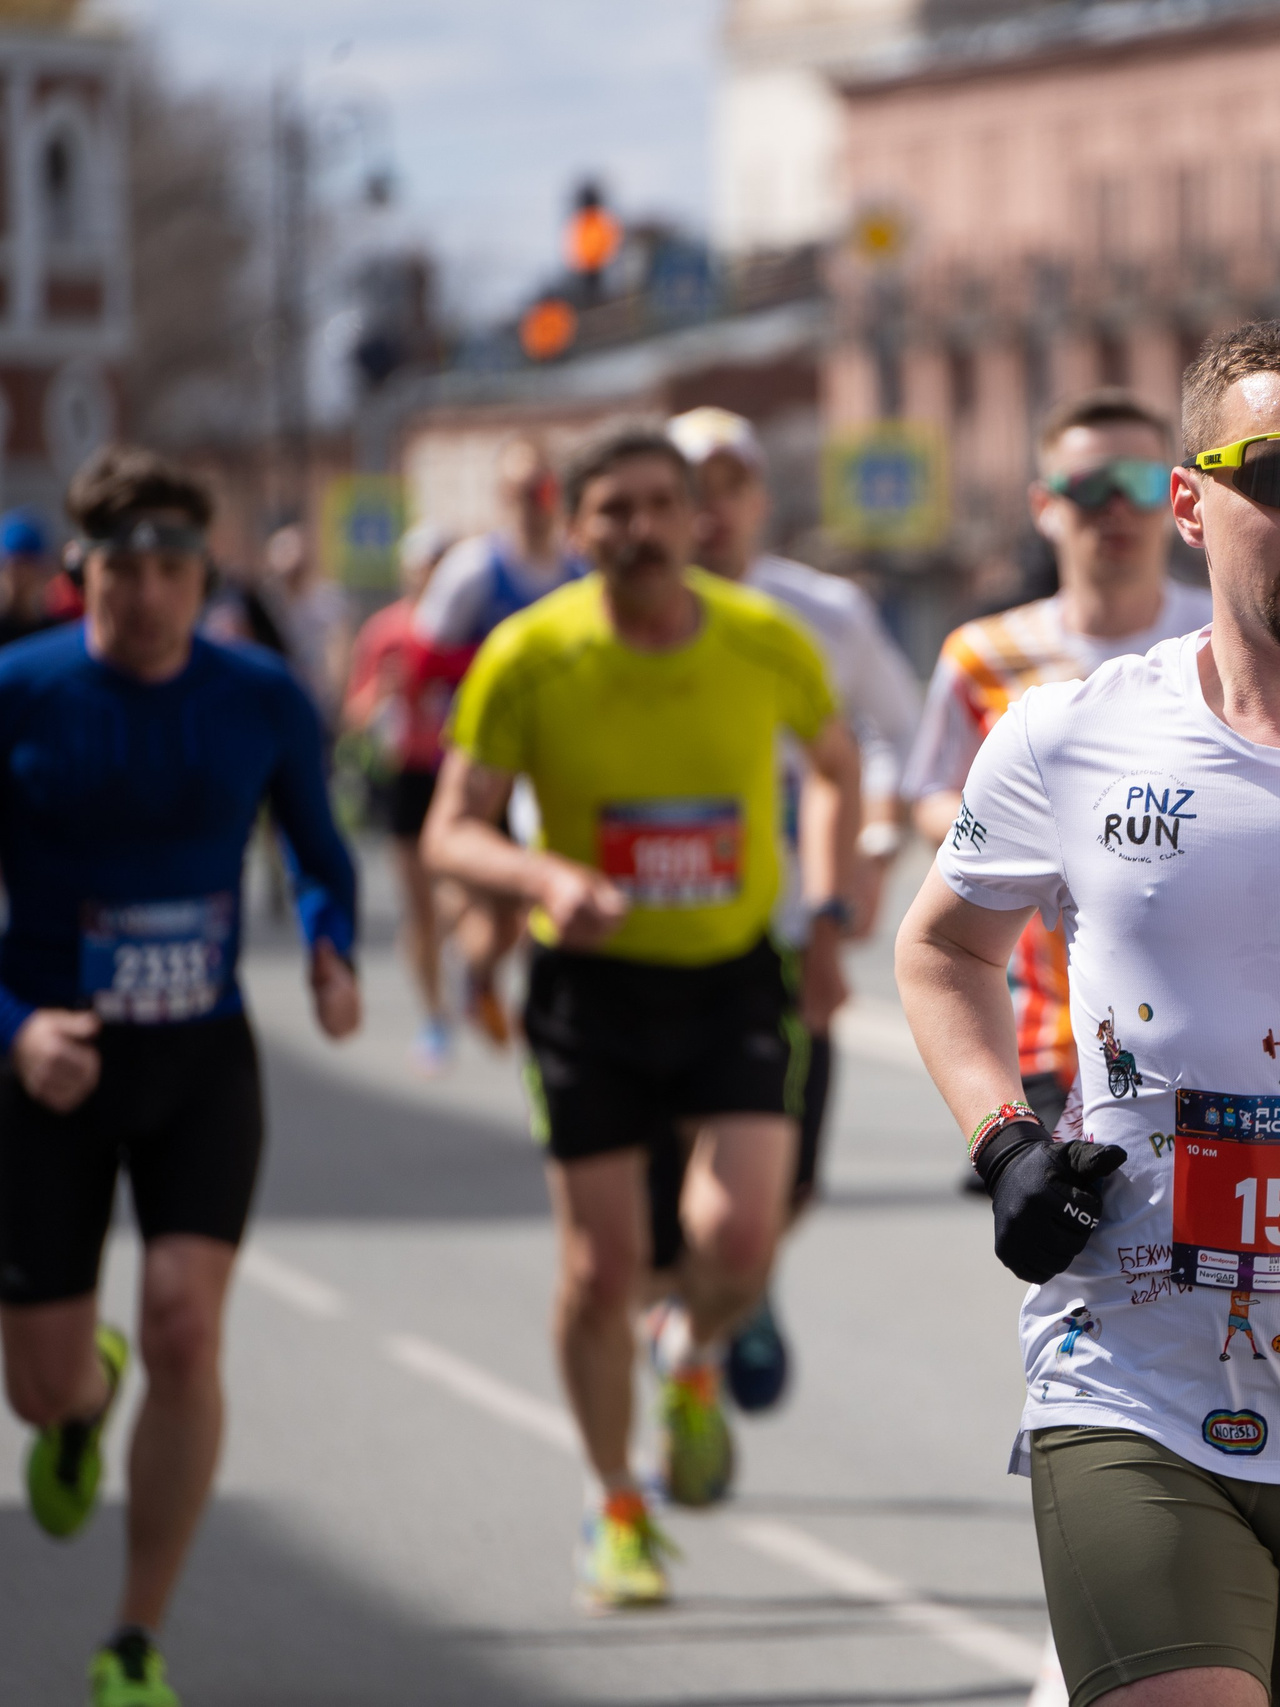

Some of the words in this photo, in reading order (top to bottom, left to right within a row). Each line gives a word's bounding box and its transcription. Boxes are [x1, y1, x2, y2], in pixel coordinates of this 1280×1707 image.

[1126, 782, 1197, 819] PNZ
[1104, 813, 1180, 850] RUN
[1159, 849, 1185, 860] CLUB
[1256, 1107, 1269, 1119] Я
[1187, 1144, 1200, 1155] 10
[1214, 1425, 1257, 1439] Nordski
